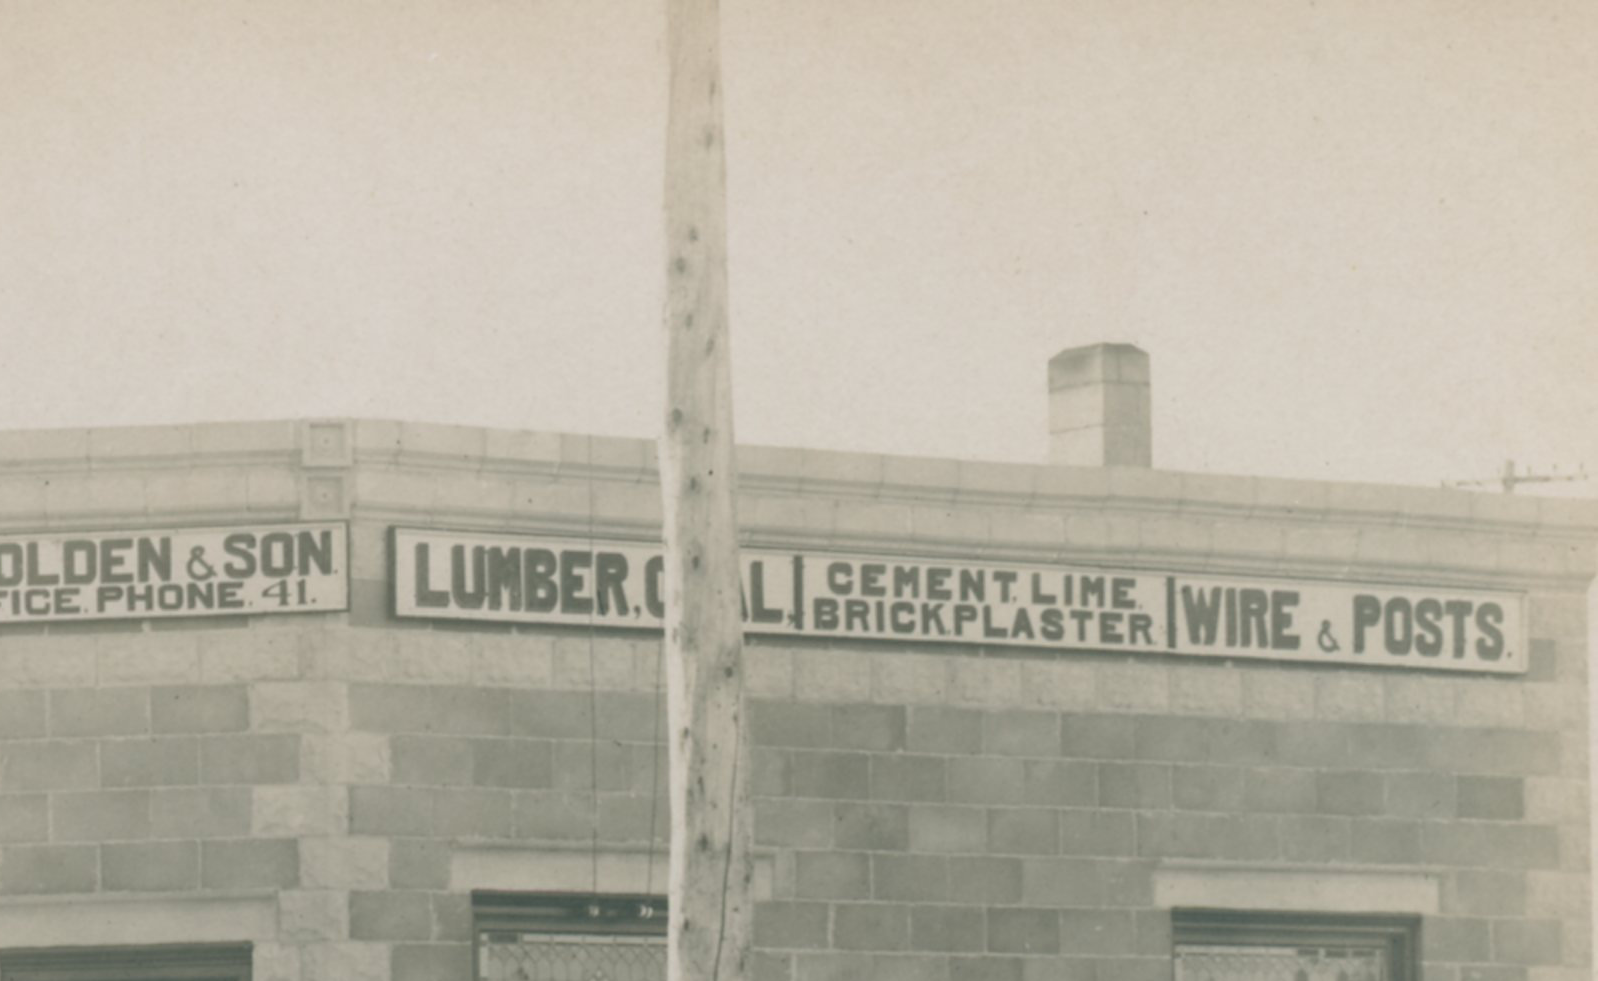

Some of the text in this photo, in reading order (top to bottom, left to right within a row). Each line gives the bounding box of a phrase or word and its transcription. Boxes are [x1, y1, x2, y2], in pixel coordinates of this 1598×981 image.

[186, 546, 217, 581] &
[223, 530, 339, 579] SON.
[415, 542, 642, 620] LUMBER,
[96, 581, 254, 613] PHONE.
[261, 579, 318, 607] 41.
[1181, 586, 1513, 662] WIRE & POSTS.
